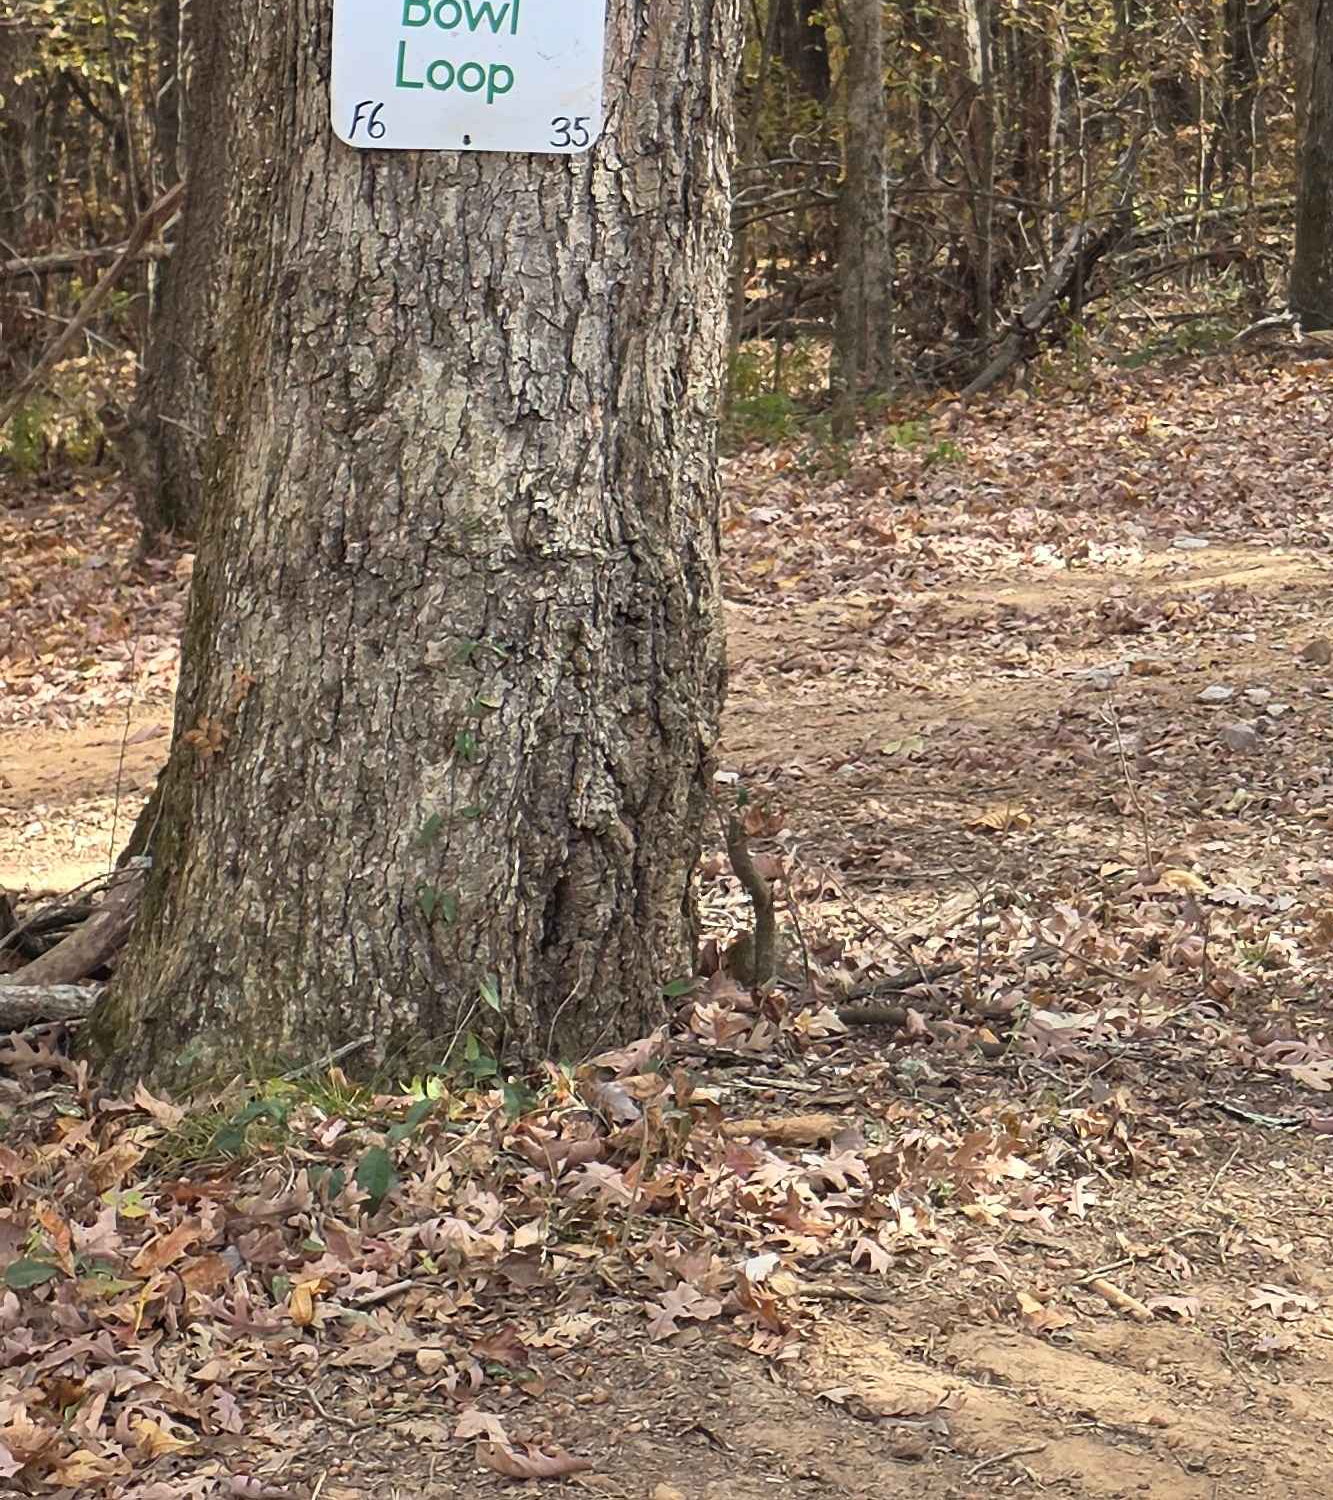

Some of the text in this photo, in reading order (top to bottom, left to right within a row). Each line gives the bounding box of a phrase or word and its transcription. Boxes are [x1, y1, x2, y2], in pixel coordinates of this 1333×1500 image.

[395, 40, 514, 103] Loop
[348, 100, 386, 140] F6
[550, 116, 592, 148] 35
